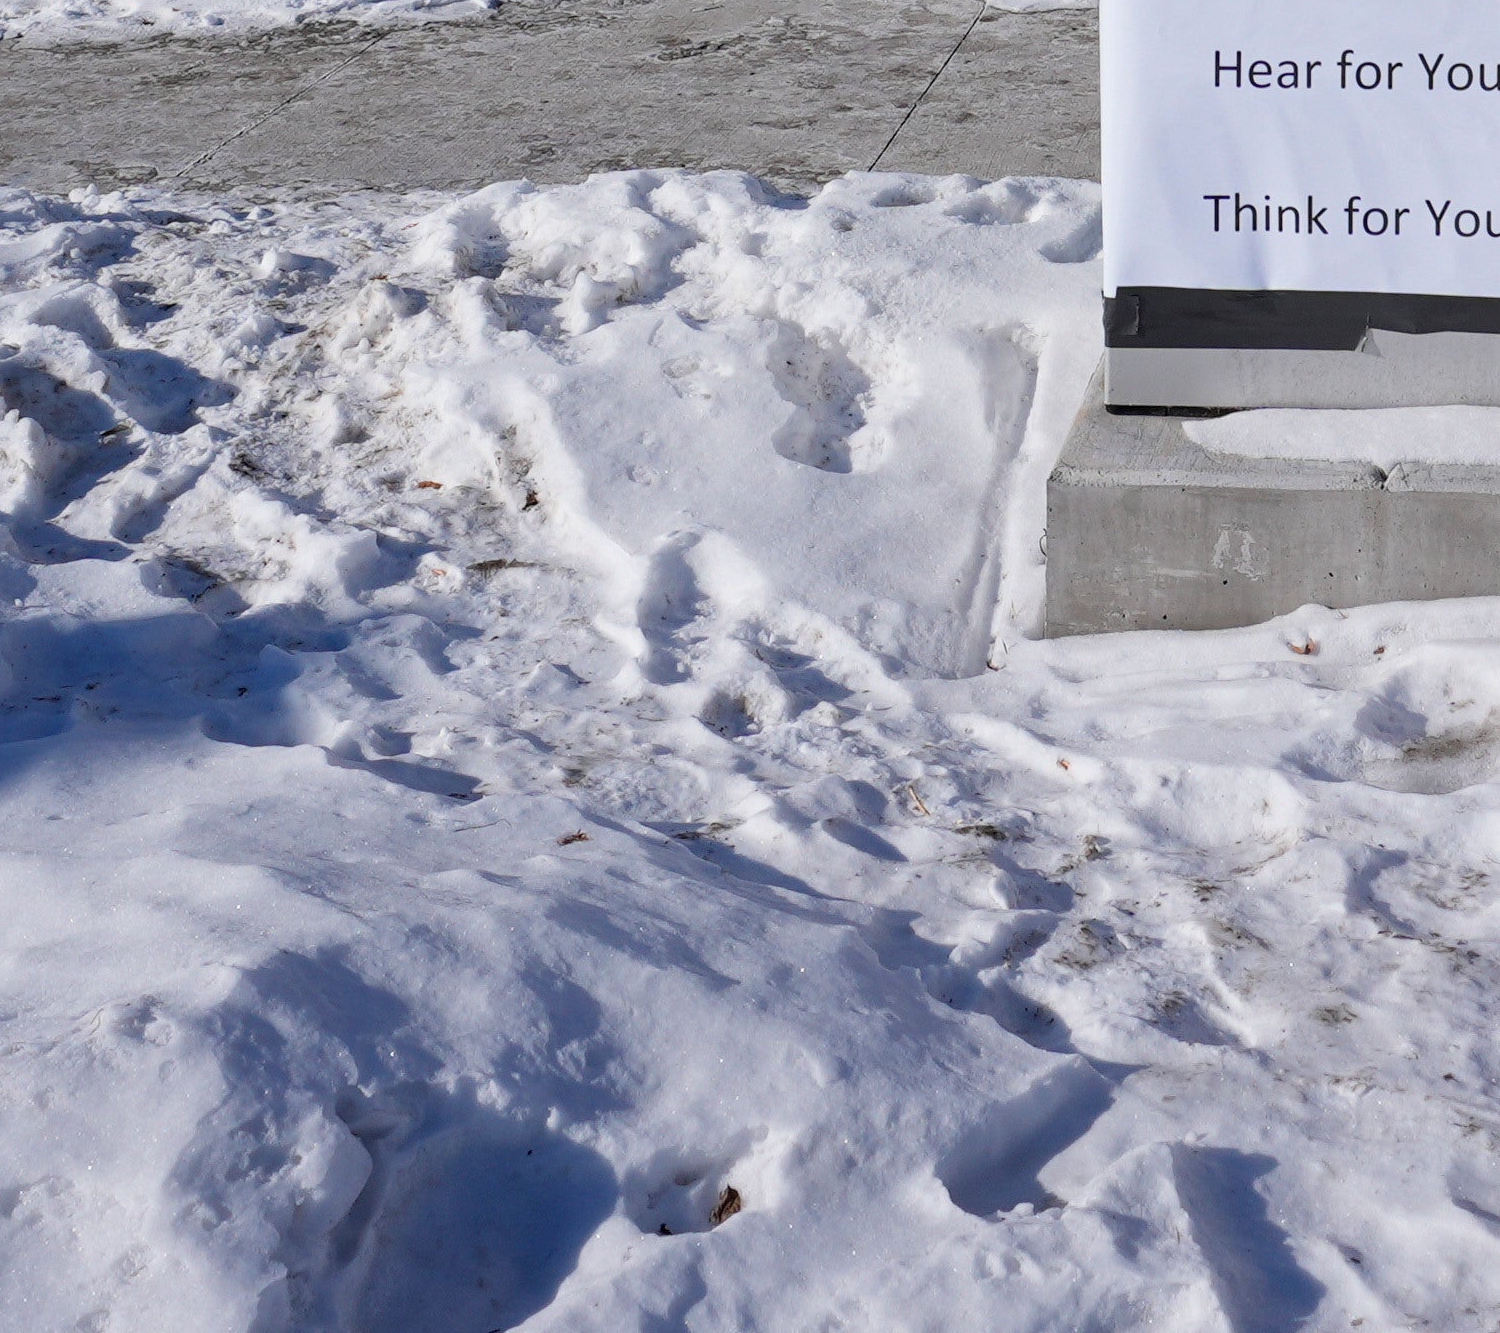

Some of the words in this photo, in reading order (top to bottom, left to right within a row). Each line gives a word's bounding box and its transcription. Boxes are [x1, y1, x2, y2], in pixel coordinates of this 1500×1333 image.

[1214, 50, 1322, 90] Hear
[1336, 49, 1403, 90] for
[1203, 193, 1328, 234] Think
[1344, 196, 1410, 236] for
